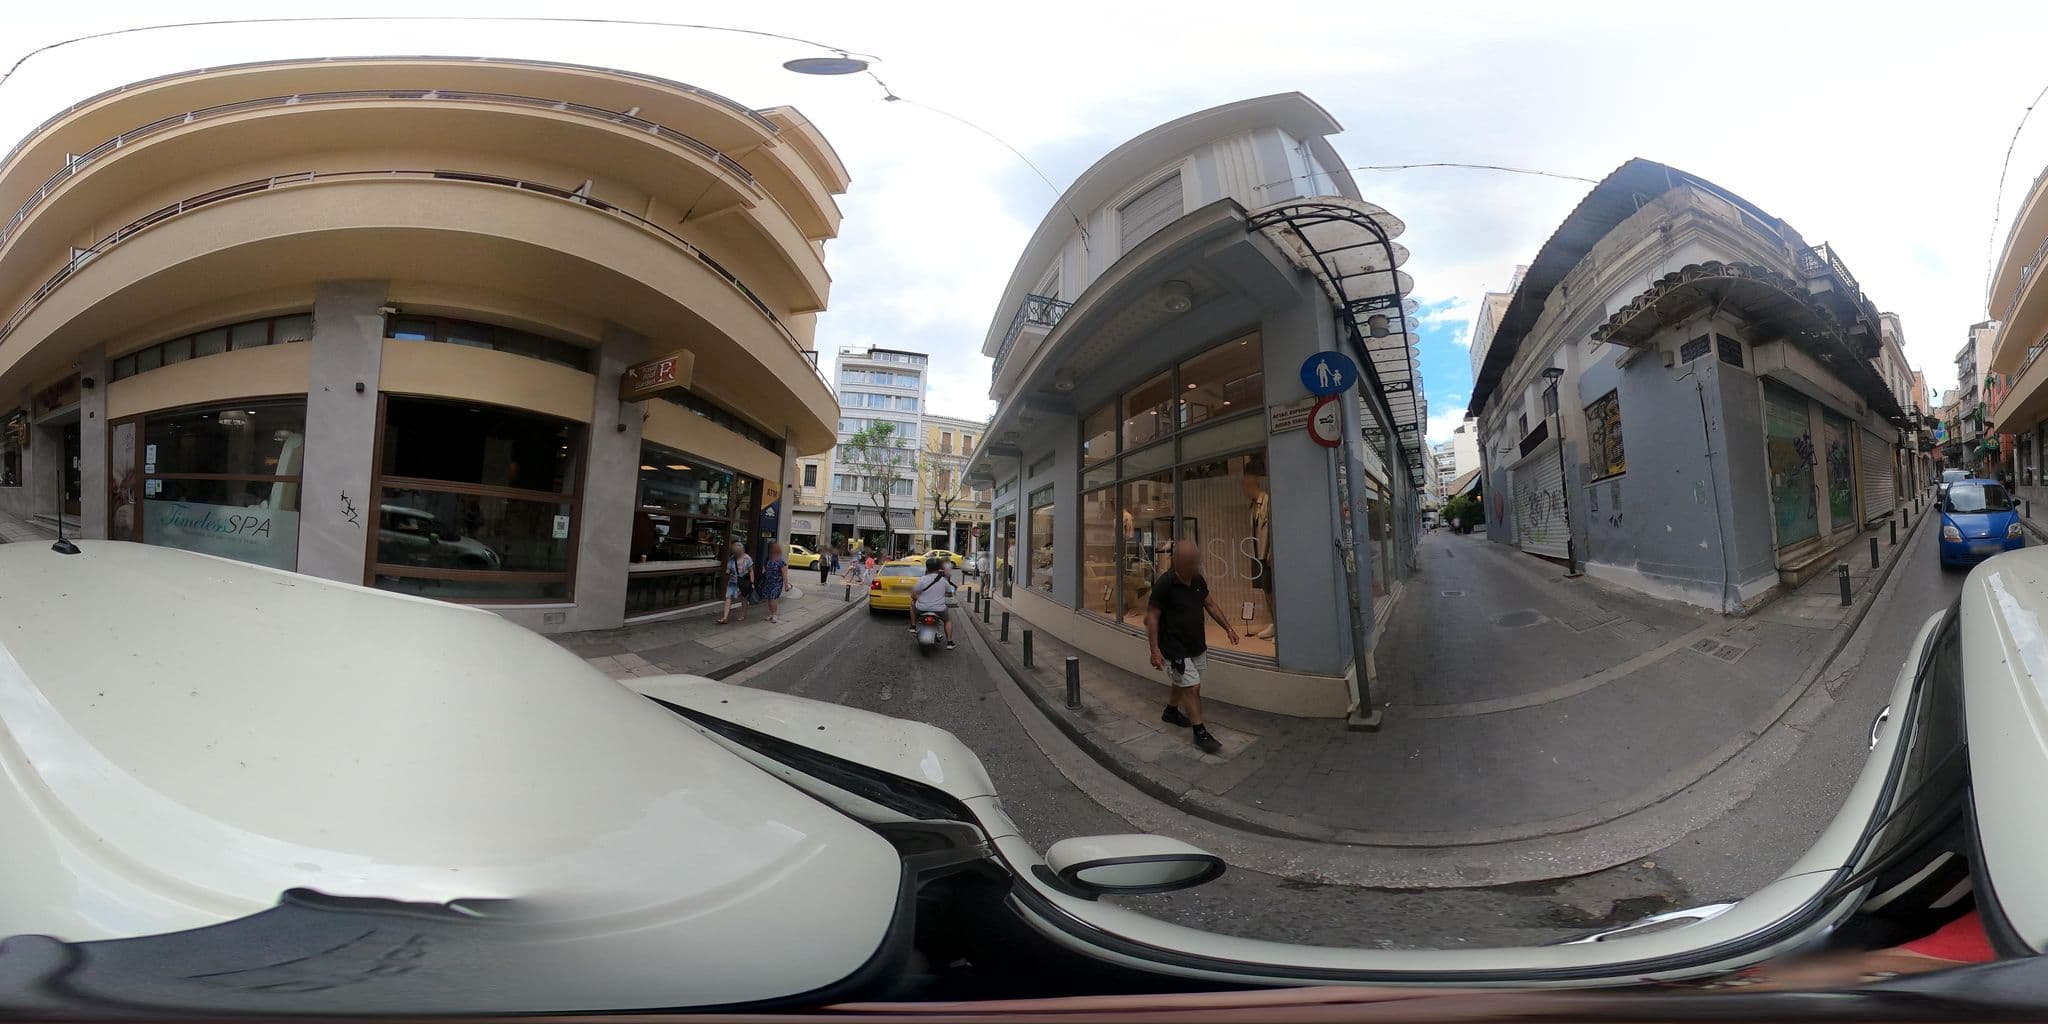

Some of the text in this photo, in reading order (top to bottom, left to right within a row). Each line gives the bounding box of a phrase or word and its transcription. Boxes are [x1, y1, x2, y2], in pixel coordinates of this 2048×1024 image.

[161, 503, 228, 532] Timeless
[226, 514, 271, 538] SPA
[1126, 536, 1263, 580] ENTSIS
